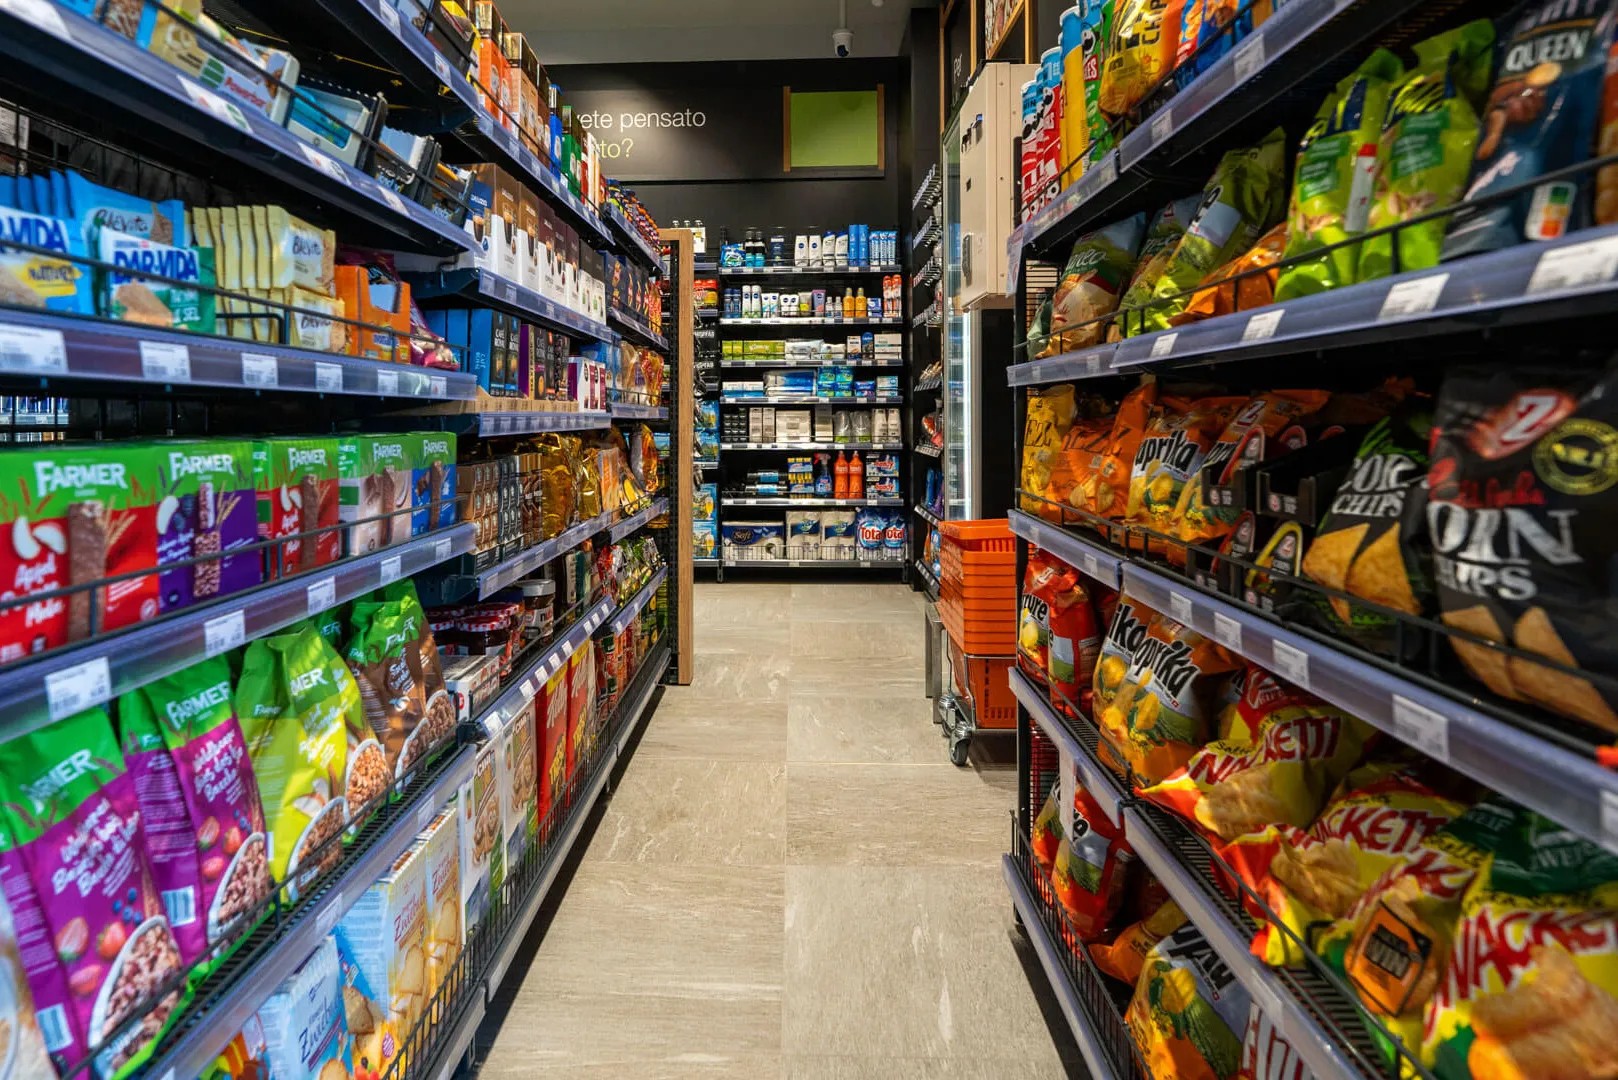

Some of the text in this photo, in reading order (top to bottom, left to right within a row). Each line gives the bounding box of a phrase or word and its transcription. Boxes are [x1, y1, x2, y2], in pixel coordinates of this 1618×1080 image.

[1506, 30, 1591, 72] QUEEN
[577, 108, 706, 133] ete pensato
[599, 138, 634, 158] to?
[287, 447, 327, 472] FARMER
[372, 442, 402, 463] FARMER
[424, 440, 447, 457] FARMER
[33, 460, 128, 497] FARMER
[168, 452, 235, 481] FARMER
[1331, 492, 1406, 517] CHIPS
[860, 527, 882, 540] Tota
